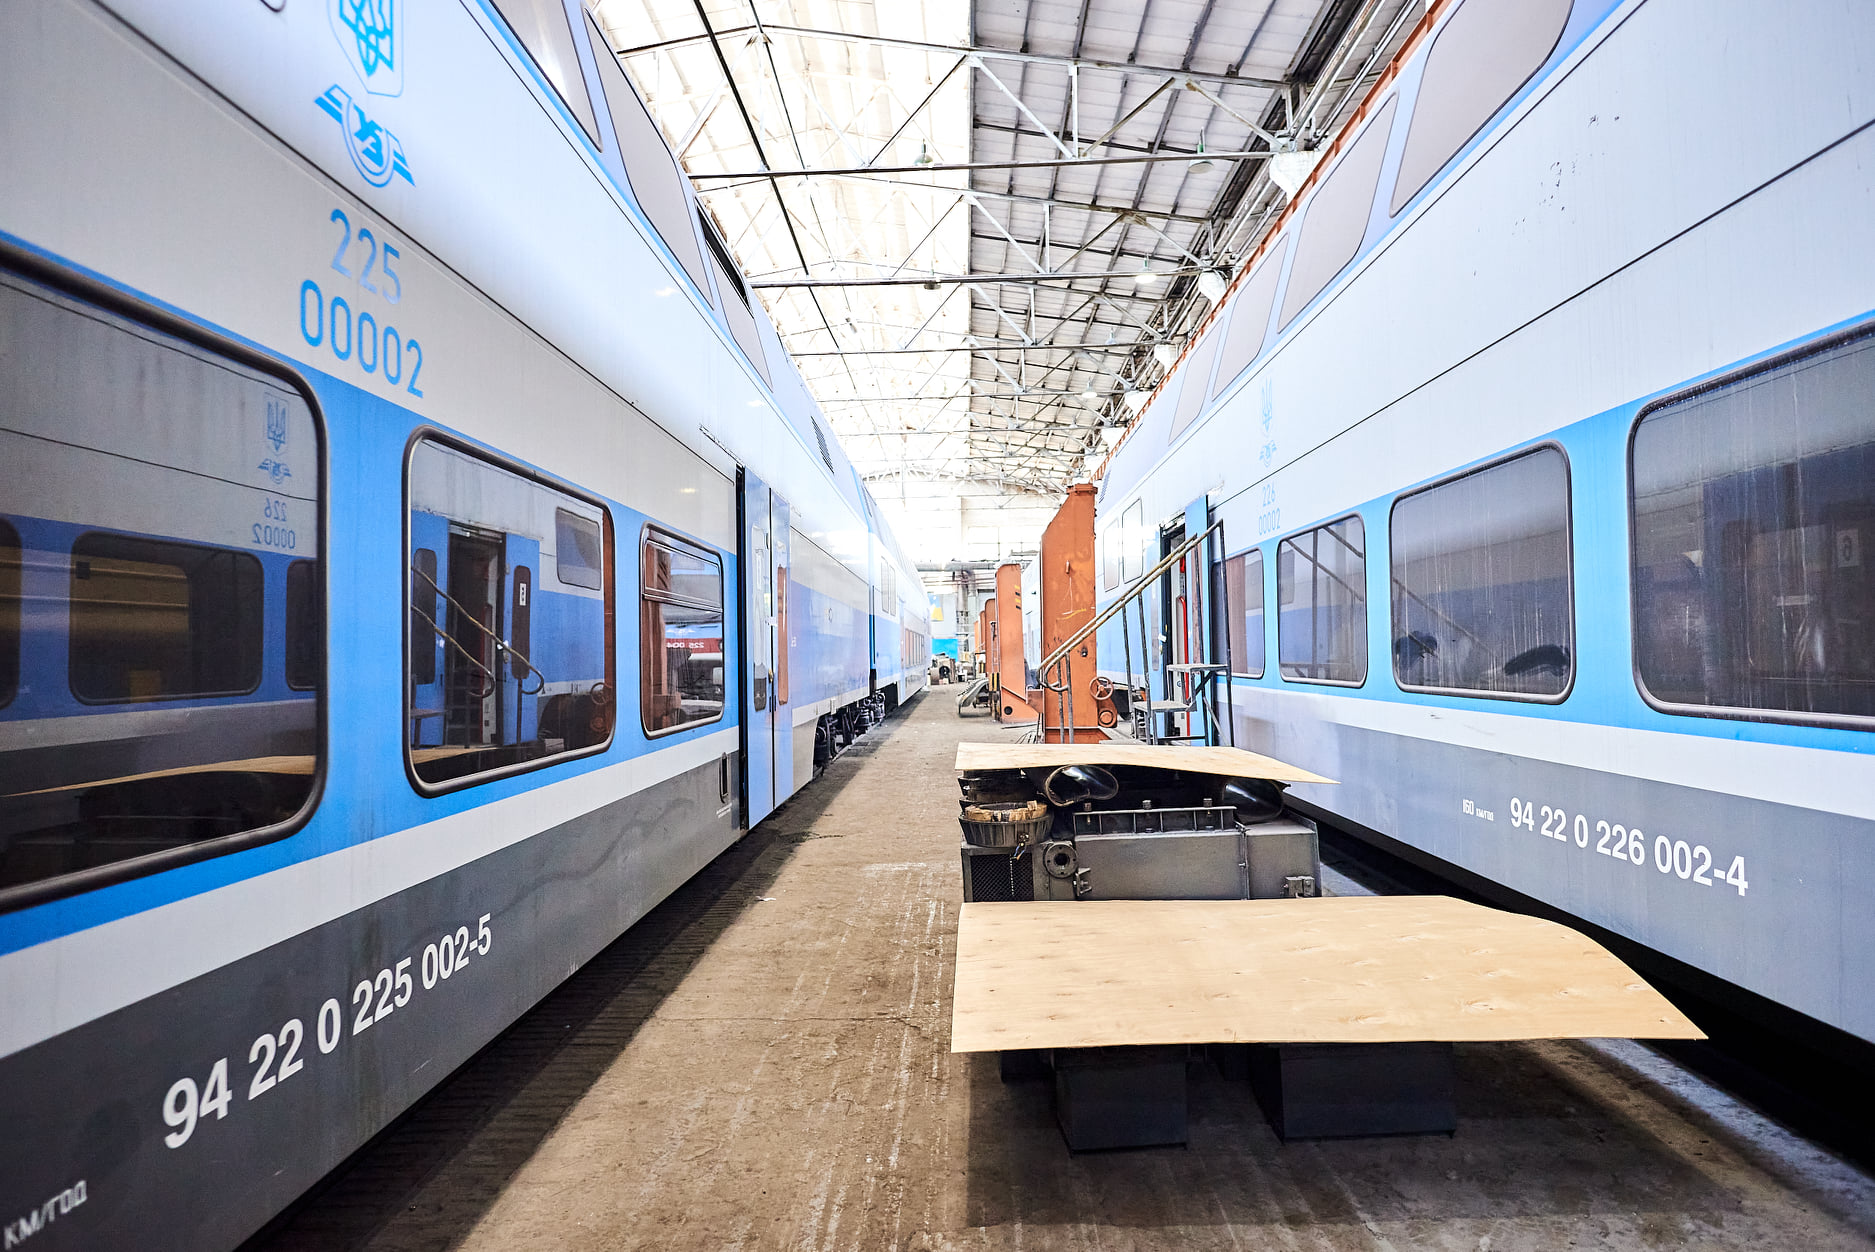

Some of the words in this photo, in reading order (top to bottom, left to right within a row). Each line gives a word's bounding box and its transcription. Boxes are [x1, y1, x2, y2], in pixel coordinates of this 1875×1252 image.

[330, 208, 401, 304] 225
[300, 279, 424, 399] 00002
[1258, 507, 1281, 535] 00002
[1262, 480, 1276, 507] 226
[1462, 799, 1475, 815] 160
[1510, 797, 1535, 831] 94
[1540, 805, 1567, 842] 22
[1574, 814, 1589, 848] 0
[1596, 820, 1646, 866] 226
[1654, 835, 1749, 896] 002-4
[162, 1057, 233, 1149] 94
[248, 1018, 304, 1100] 22
[317, 998, 341, 1054] 0
[352, 956, 413, 1036] 225
[421, 912, 492, 990] 002-5
